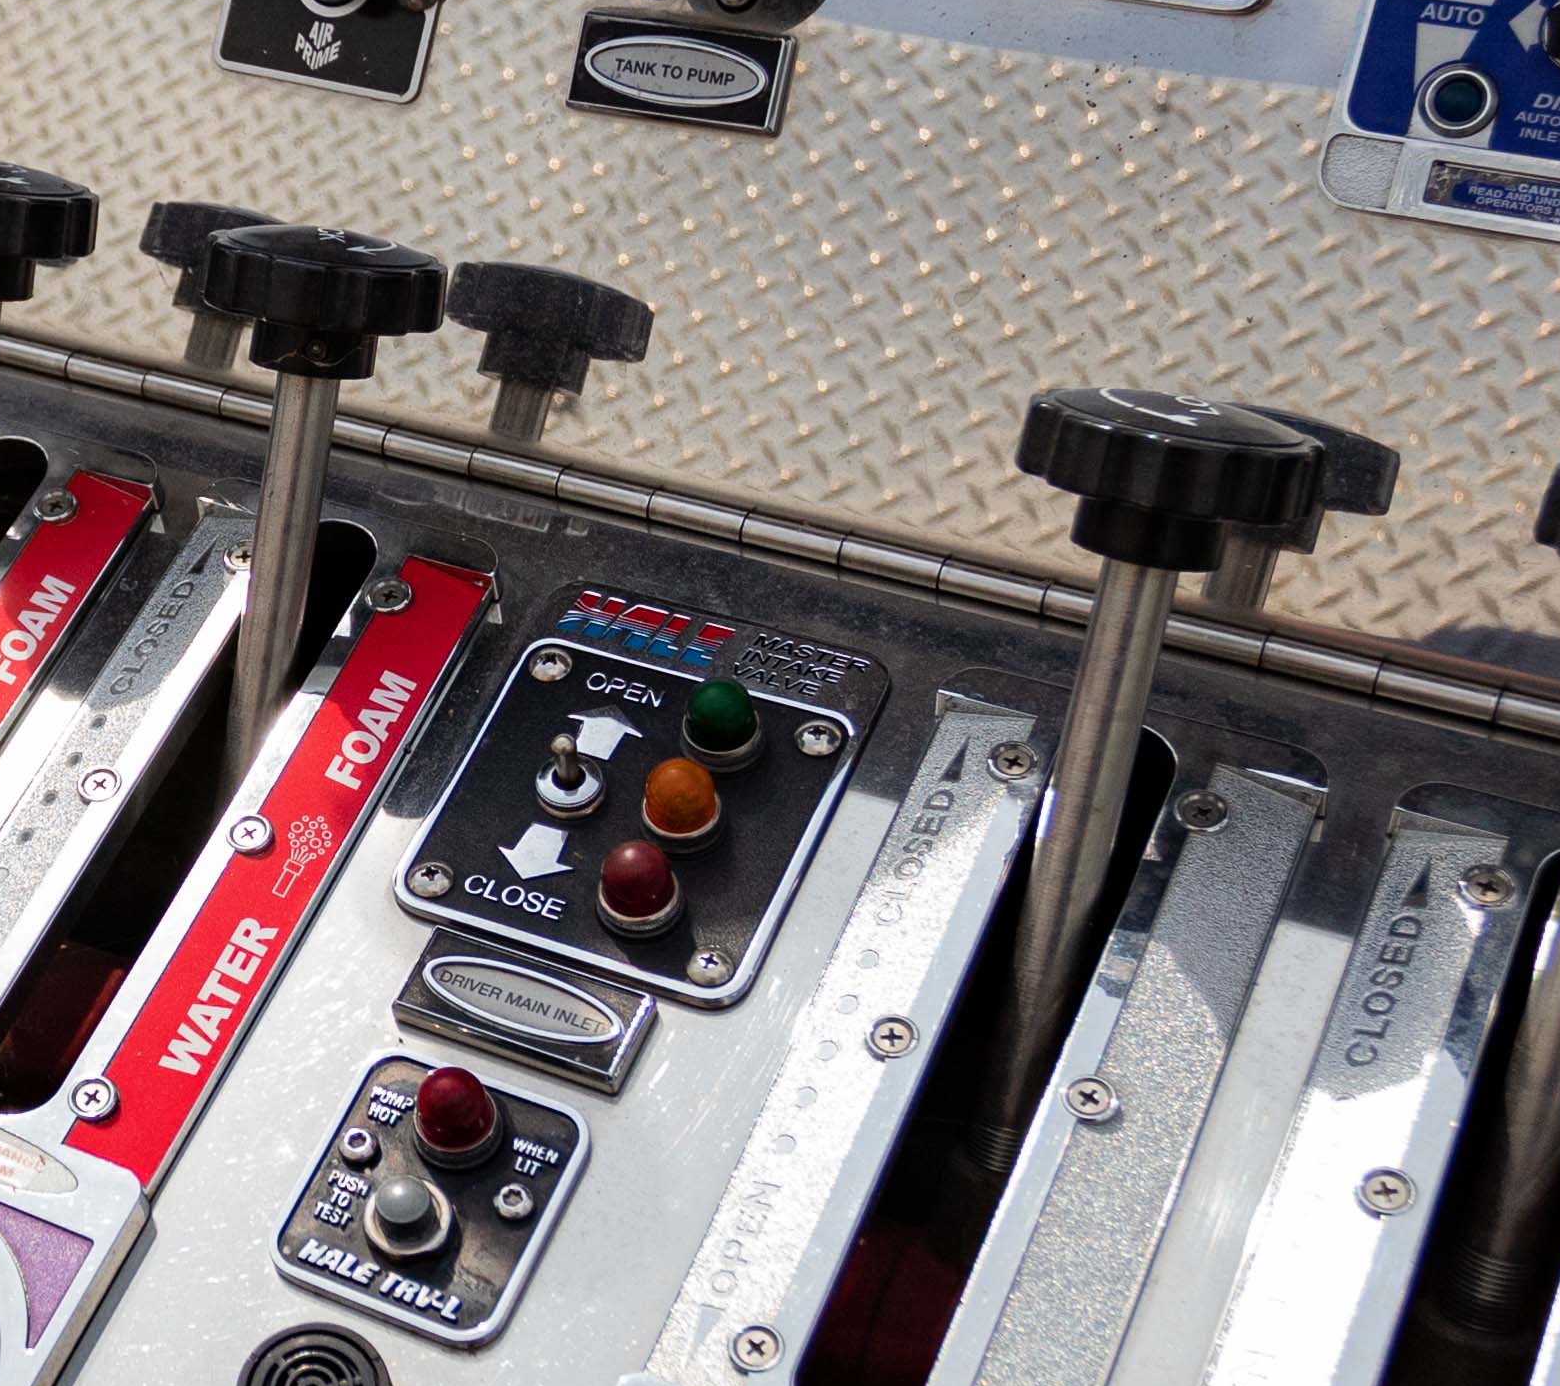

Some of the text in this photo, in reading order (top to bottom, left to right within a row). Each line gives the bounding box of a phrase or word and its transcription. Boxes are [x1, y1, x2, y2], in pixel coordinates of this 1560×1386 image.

[1421, 2, 1486, 27] AUTO
[294, 33, 341, 70] PRIME
[309, 20, 335, 49] AIR
[614, 56, 736, 88] TANK TO PUMP
[741, 650, 845, 686] INTAKE
[752, 634, 871, 674] MASTER
[585, 672, 666, 709] OPEN
[730, 661, 822, 698] VALVE
[325, 670, 418, 790] FOAM
[463, 874, 566, 920] CLOSE
[159, 917, 279, 1078] WATER
[438, 968, 604, 1033] DRIVER MAIN INLET
[1345, 913, 1423, 1067] CLOSED
[369, 1104, 401, 1125] HOT
[370, 1086, 415, 1111] PUMP
[512, 1139, 559, 1164] WHEN
[515, 1156, 541, 1176] LIT
[328, 1169, 370, 1195] PUSH
[330, 1189, 350, 1209] TO
[314, 1202, 353, 1228] TEST
[298, 1238, 380, 1284] HALE
